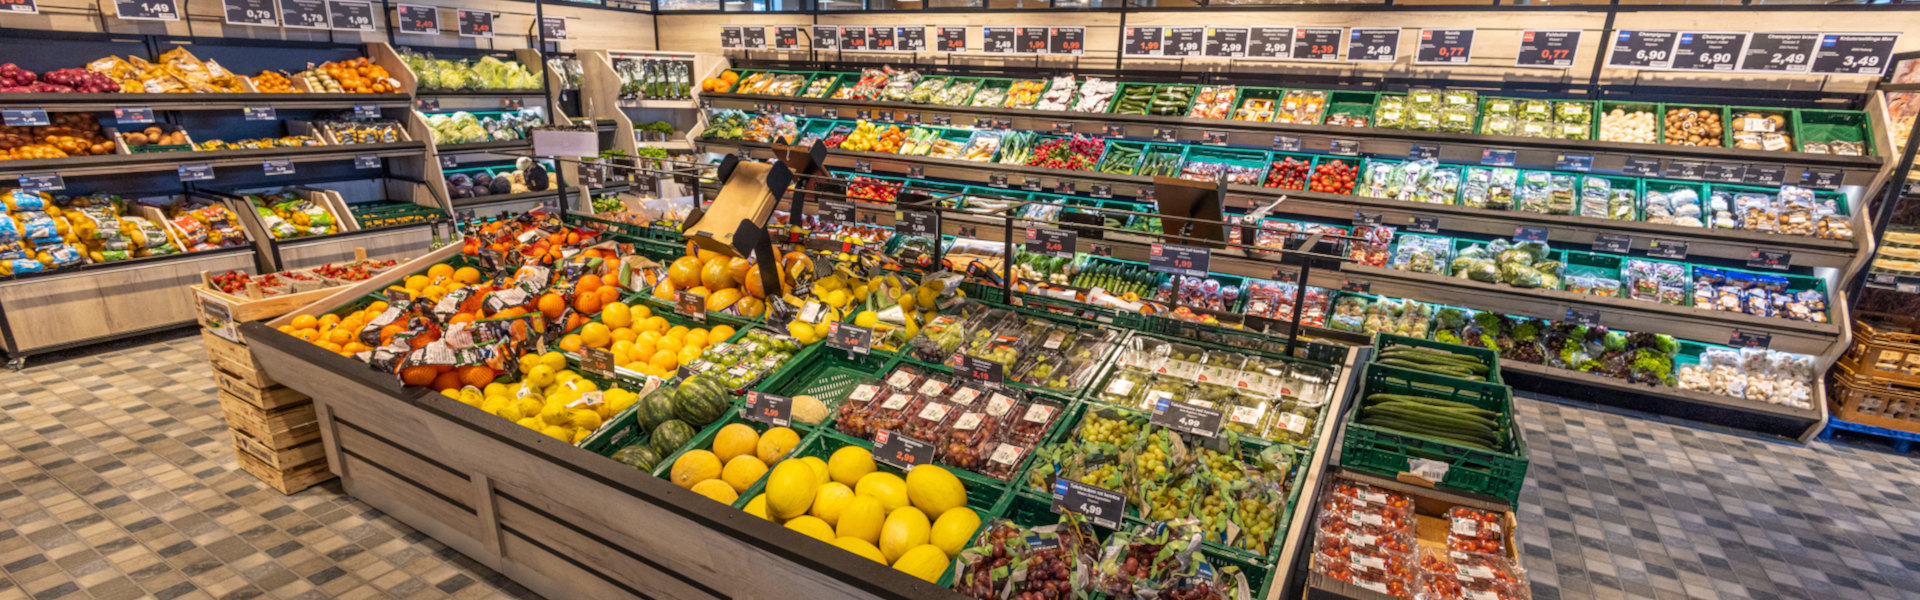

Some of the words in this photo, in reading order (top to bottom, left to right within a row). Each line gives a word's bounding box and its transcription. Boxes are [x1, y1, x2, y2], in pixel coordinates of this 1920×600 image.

[141, 2, 170, 14] 1,49
[246, 9, 271, 20] 0,79
[301, 13, 324, 22] 1,79
[348, 16, 369, 25] 1,99
[908, 39, 923, 48] 2,49
[995, 40, 1013, 50] 2,49
[1140, 41, 1160, 51] 1,99
[1178, 42, 1199, 52] 1,99
[1221, 43, 1243, 54] 2,99
[1264, 43, 1287, 54] 2,99
[1311, 44, 1335, 55] 2,39
[1366, 45, 1392, 57] 2,49
[1438, 46, 1465, 58] 0,77
[1540, 49, 1570, 61] 0,77
[1636, 49, 1667, 61] 6,90
[1699, 52, 1732, 64] 6,90
[1770, 52, 1806, 65] 2,49
[1842, 55, 1880, 67] 3,49
[1178, 416, 1201, 428] 4,99
[895, 450, 915, 464] 2,99
[1079, 502, 1103, 516] 4,99
